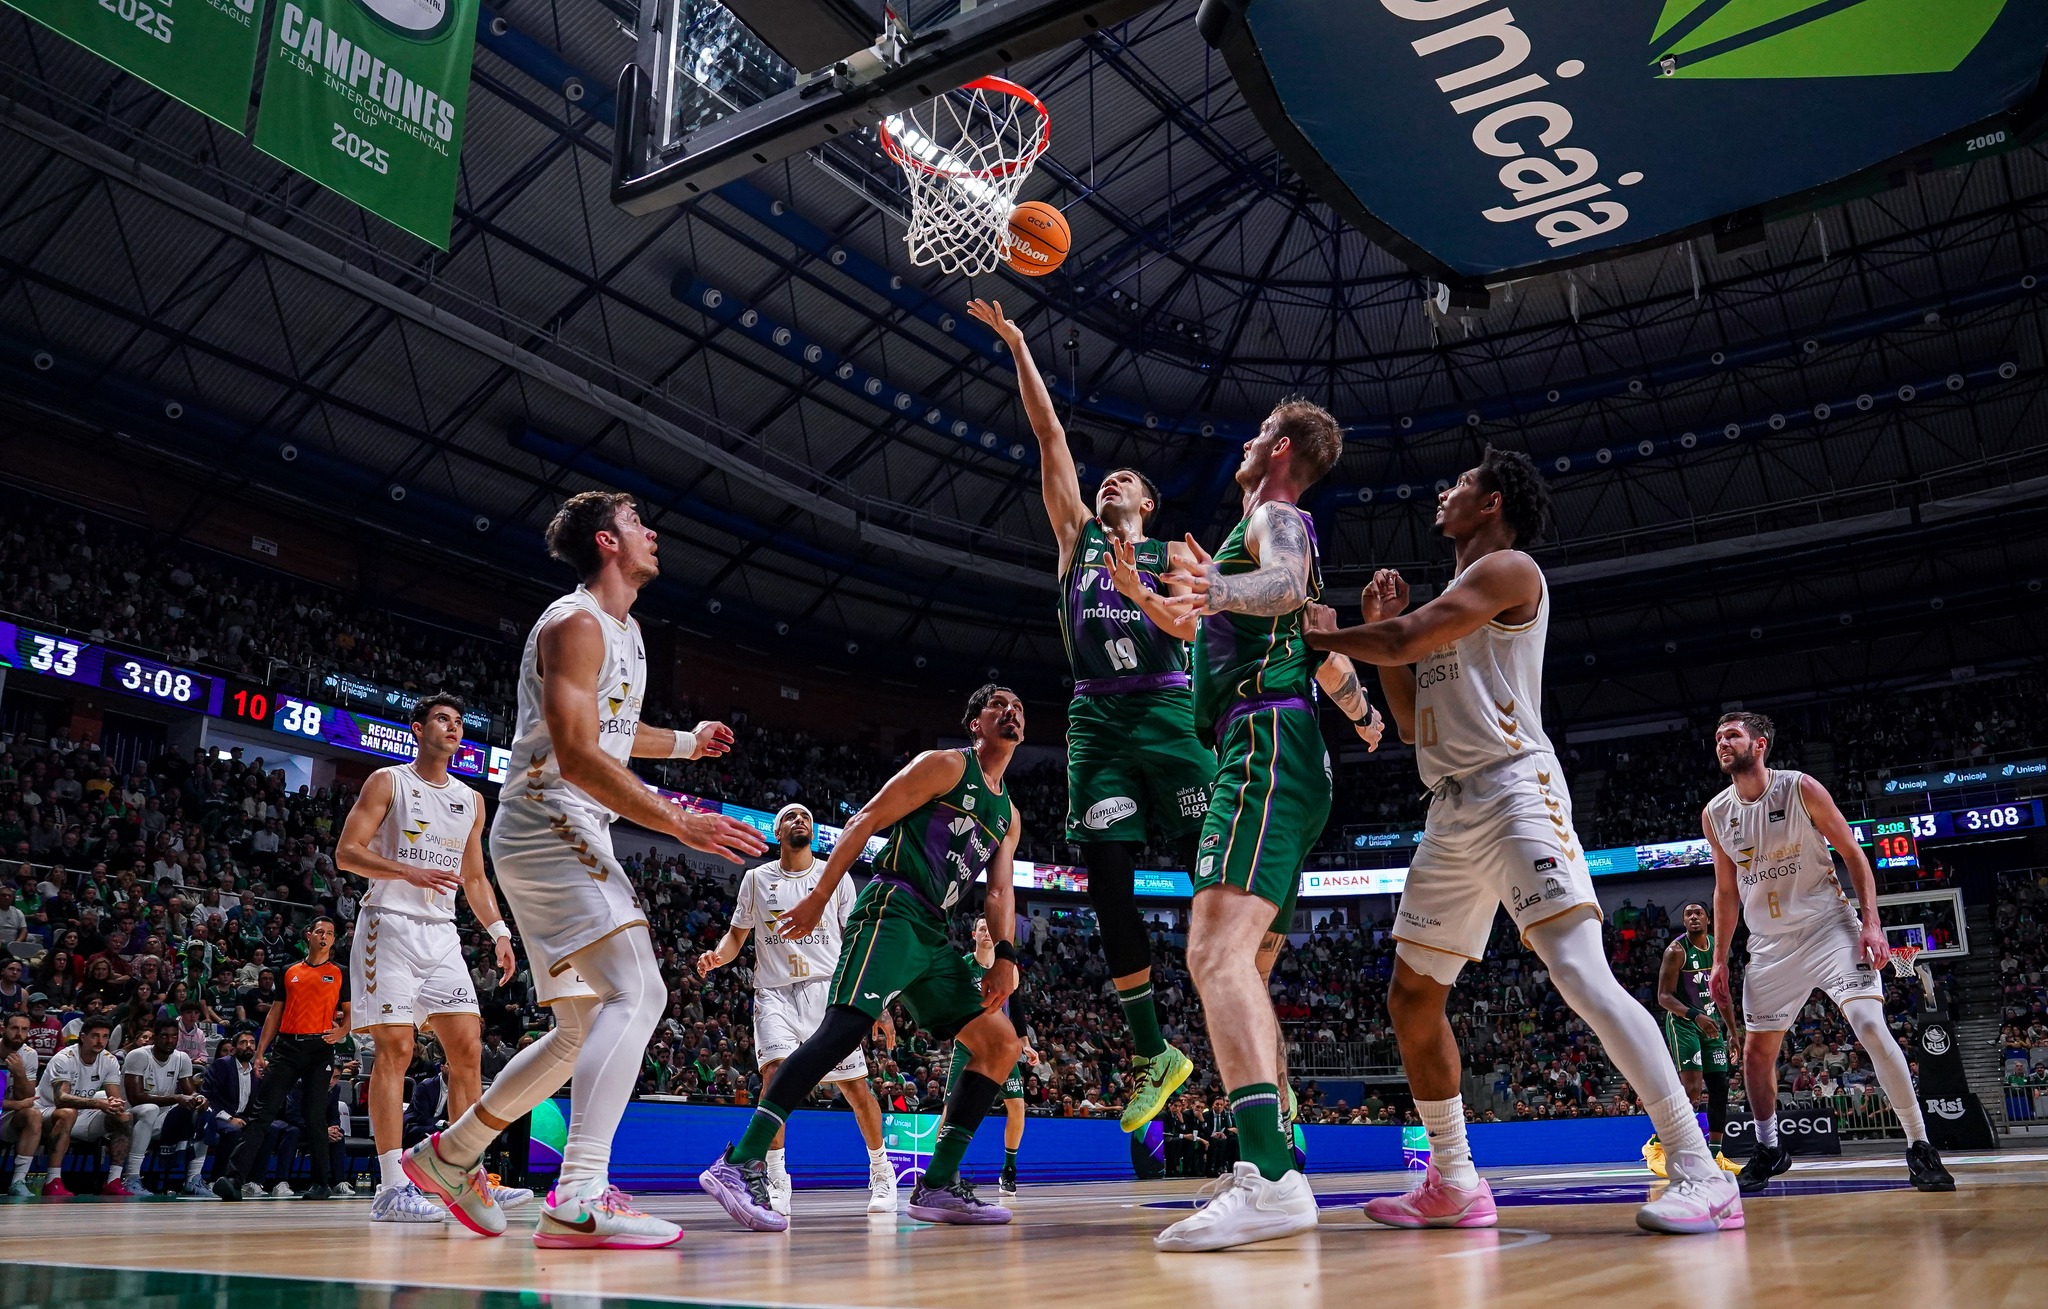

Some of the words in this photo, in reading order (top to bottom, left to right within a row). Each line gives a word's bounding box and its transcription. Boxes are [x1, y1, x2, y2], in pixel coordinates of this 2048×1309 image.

[280, 2, 455, 142] CAMPEONES
[279, 46, 314, 77] FIBA
[322, 72, 449, 157] INTERCONTINENTAL
[353, 107, 378, 127] CUP
[331, 122, 390, 175] 2025
[1966, 131, 2007, 152] 2000
[1082, 602, 1141, 623] málaga
[30, 634, 79, 676] 33
[1104, 637, 1138, 671] 19
[121, 661, 192, 702] 3:08
[234, 691, 267, 721] 10
[282, 700, 322, 737] 38
[360, 734, 381, 749] SAN
[381, 739, 411, 756] PABLO
[1957, 771, 1987, 782] Unicaja
[2016, 763, 2047, 775] Unicaja
[1176, 786, 1196, 797] sabor
[1898, 779, 1928, 790] Unicaja
[1089, 801, 1135, 823] famadesa
[1179, 801, 1209, 818] laga
[1966, 806, 2020, 830] 3:08
[1368, 832, 1400, 841] Fundación
[1876, 821, 1906, 834] 3:08
[1368, 839, 1392, 847] Unicaja
[1879, 836, 1909, 858] 10
[409, 847, 459, 869] BURGOS
[1536, 861, 1553, 871] acb
[1322, 875, 1370, 886] ANSAN
[1426, 918, 1442, 927] LEÓN
[1926, 1041, 1946, 1051] Risi
[1925, 1097, 1965, 1113] Risi
[893, 1119, 912, 1129] Unicaja
[1725, 1116, 1832, 1138] enesa
